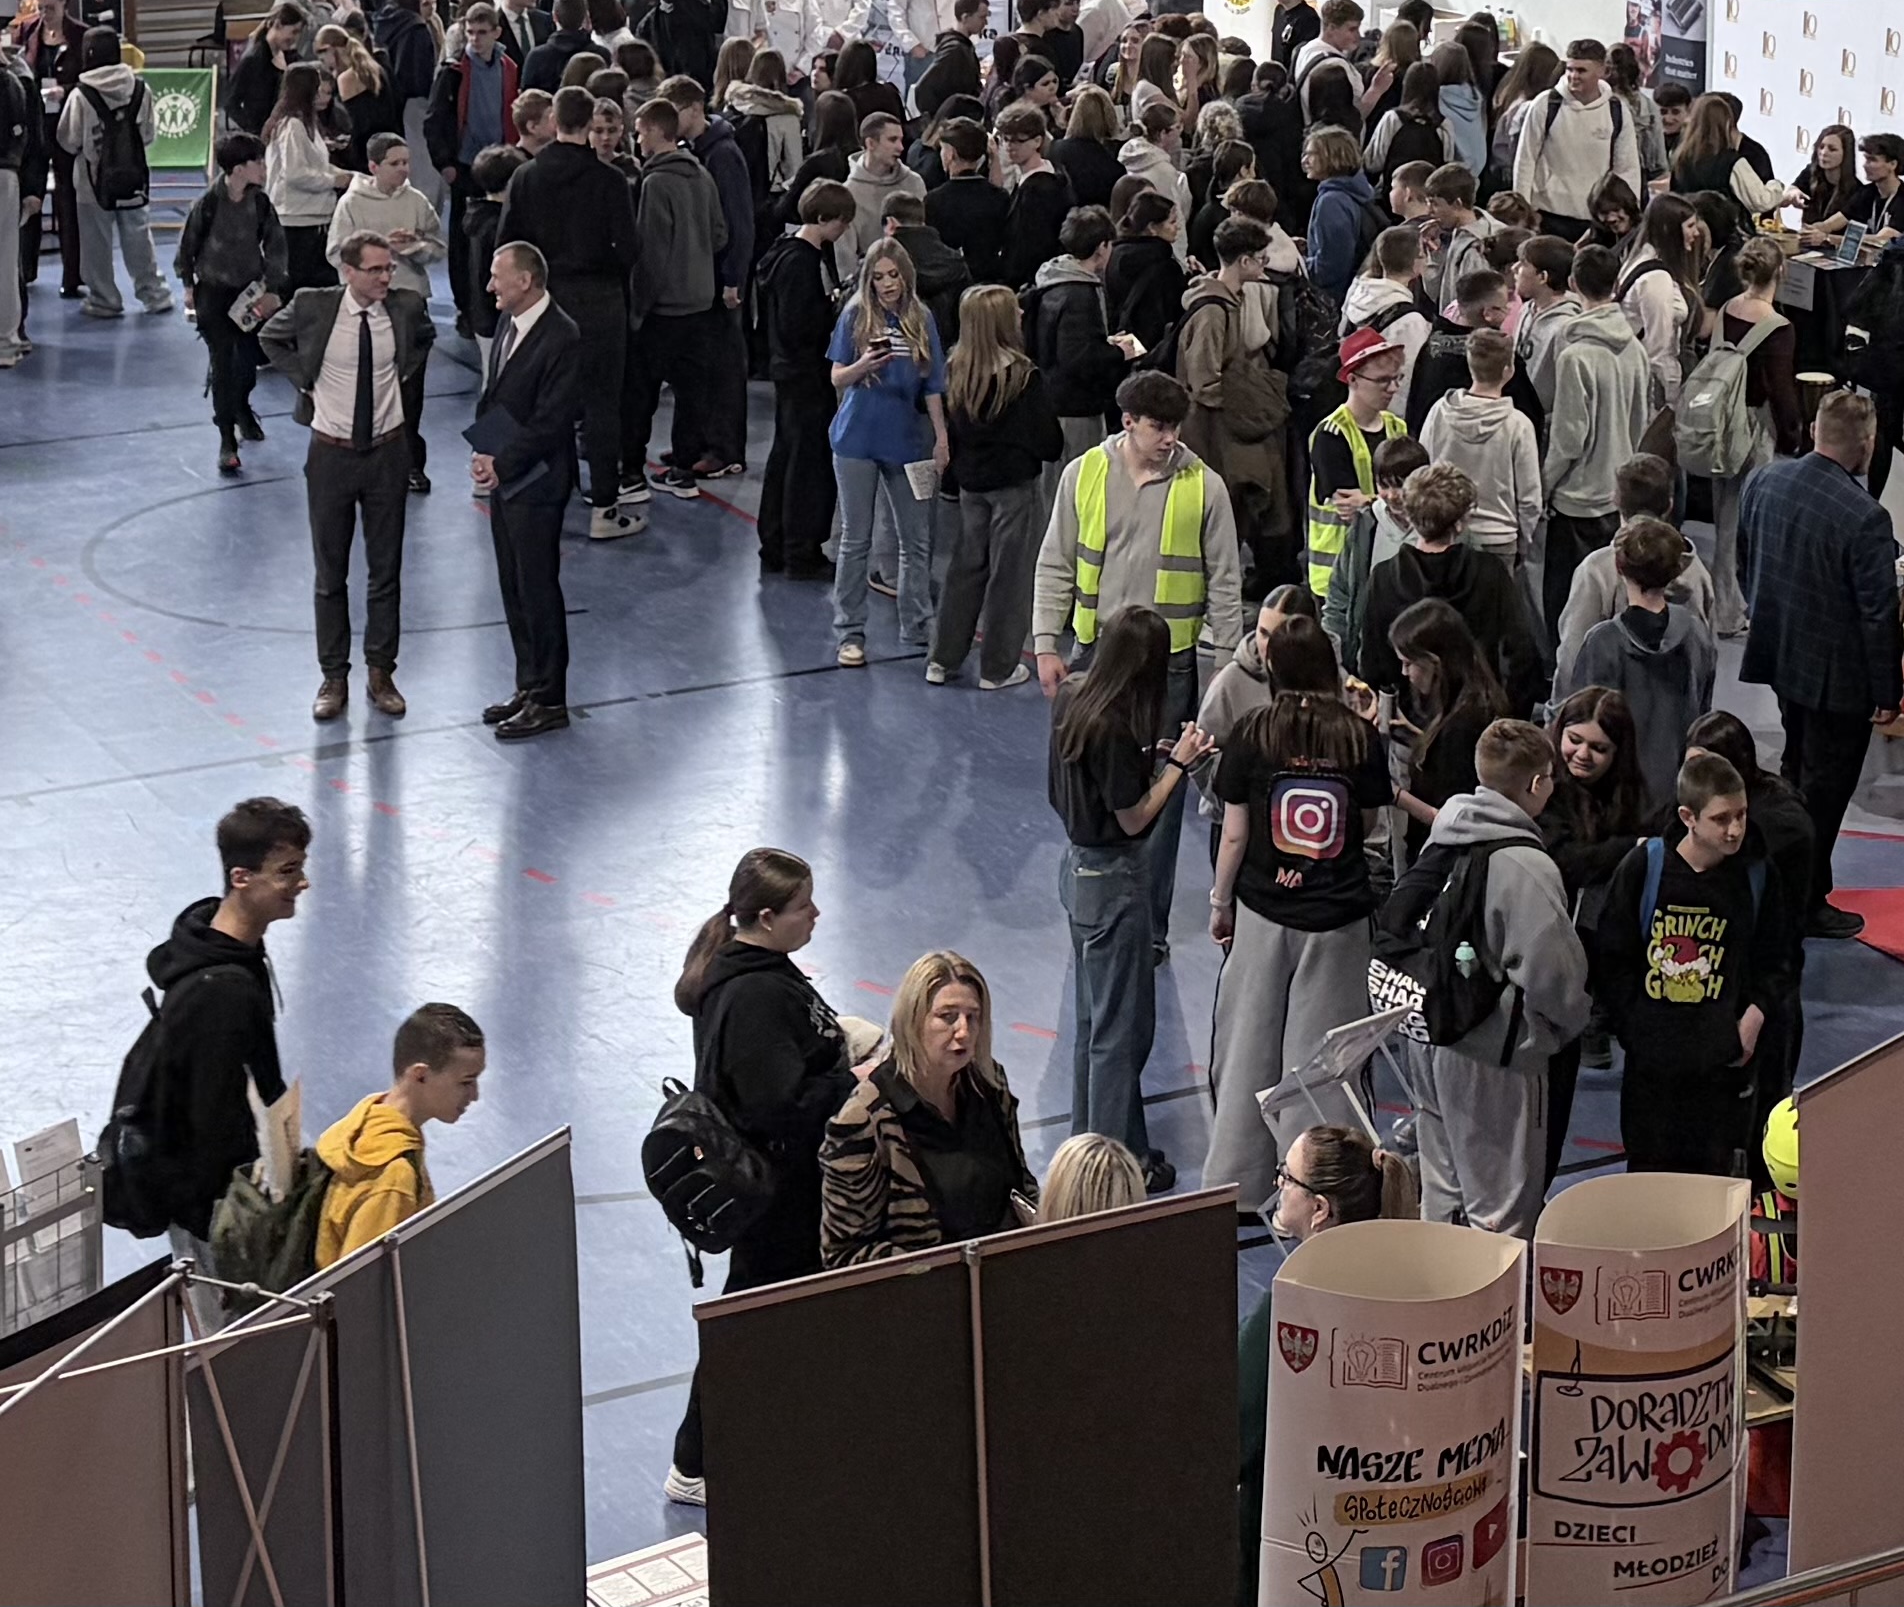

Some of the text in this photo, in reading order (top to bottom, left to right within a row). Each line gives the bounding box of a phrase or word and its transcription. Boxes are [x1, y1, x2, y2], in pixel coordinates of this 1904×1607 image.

[1650, 909, 1728, 942] GRINCH
[1678, 1246, 1737, 1292] CWRK
[1317, 1442, 1423, 1484] NASZE
[1553, 1519, 1637, 1543] DZIECI
[1613, 1533, 1719, 1579] MŁODZIEŻ
